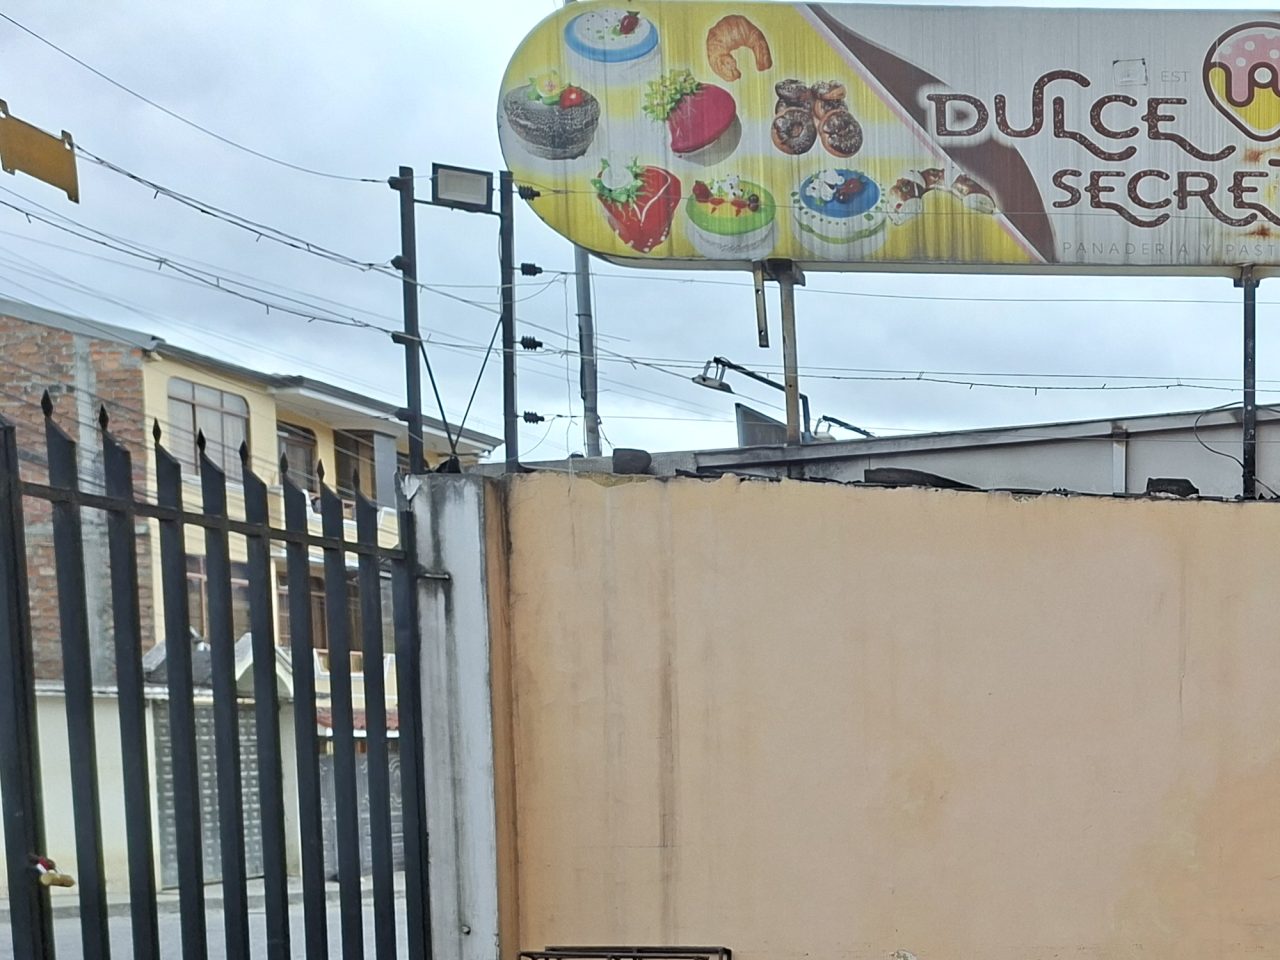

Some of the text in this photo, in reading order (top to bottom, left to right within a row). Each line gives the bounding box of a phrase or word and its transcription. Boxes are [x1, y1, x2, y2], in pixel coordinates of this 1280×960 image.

[1160, 70, 1190, 83] EST
[926, 69, 1237, 162] DULCE
[1202, 244, 1212, 256] Y
